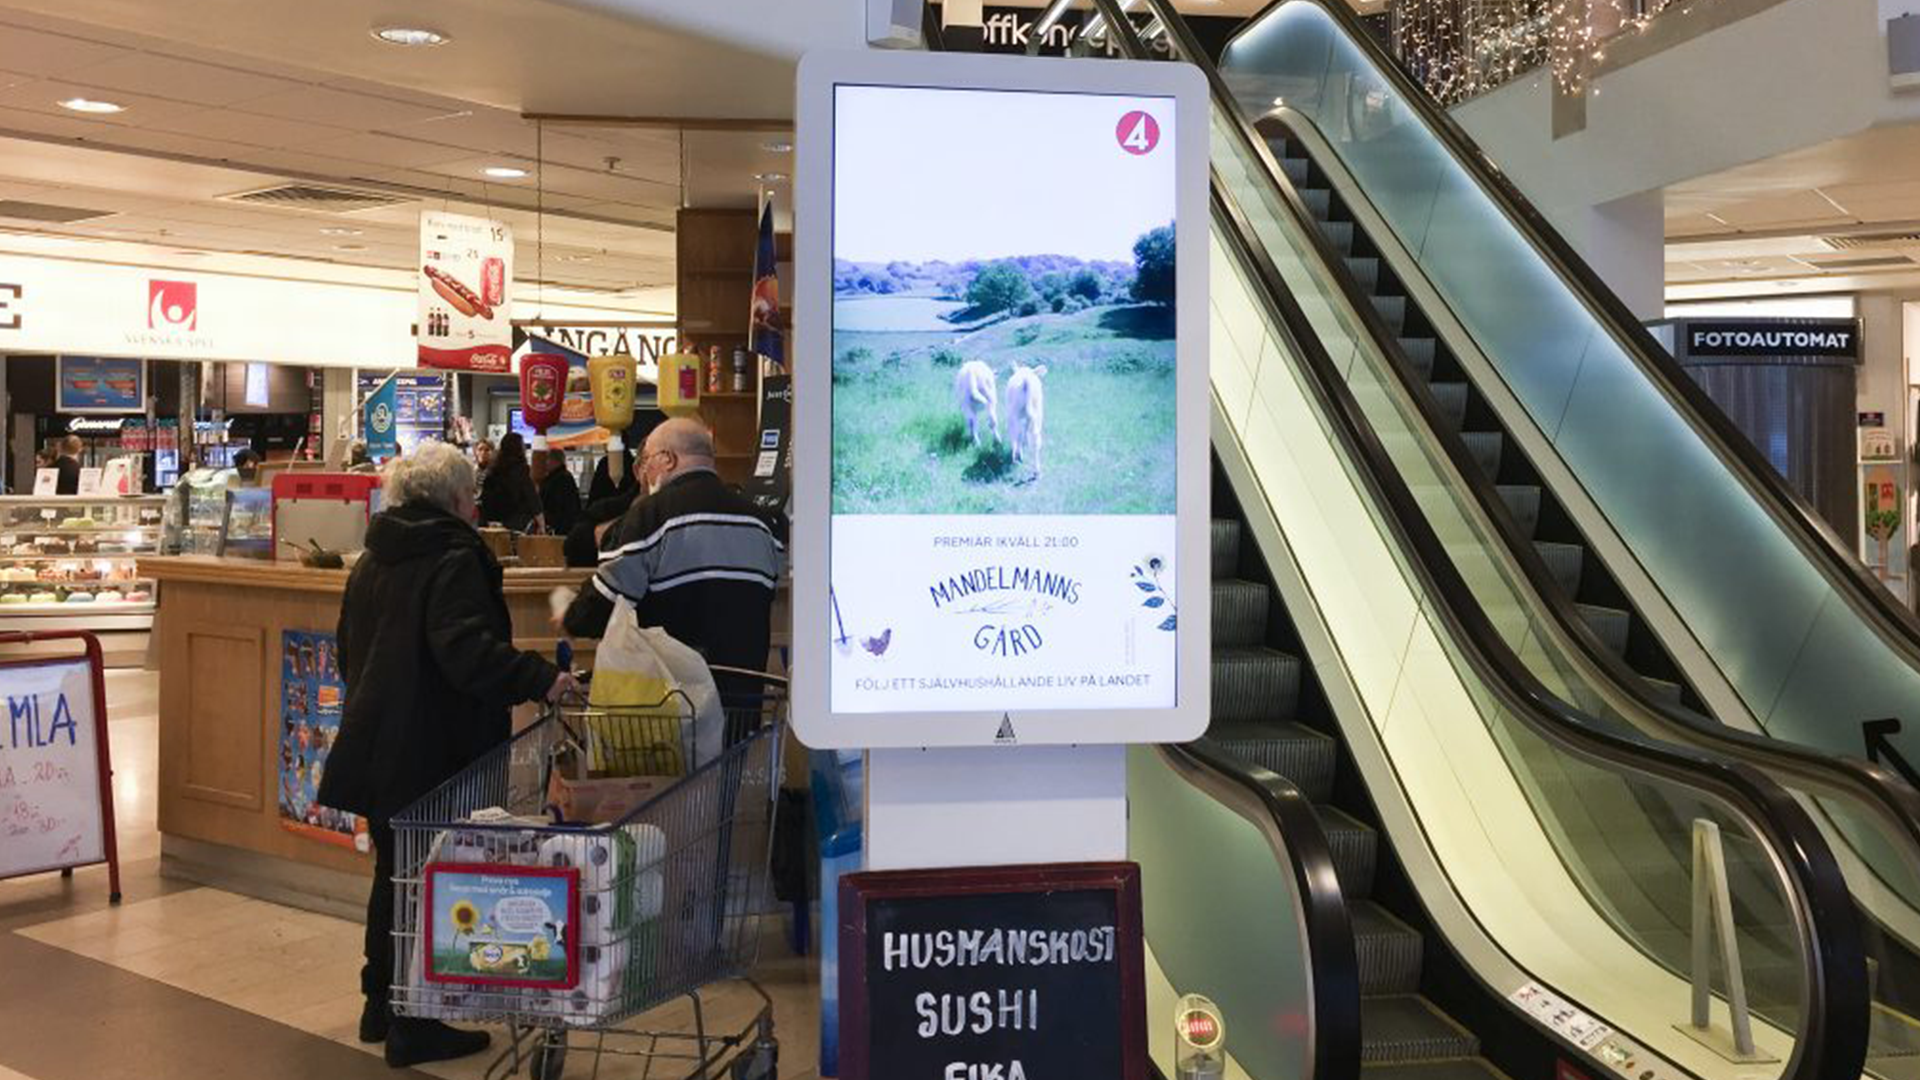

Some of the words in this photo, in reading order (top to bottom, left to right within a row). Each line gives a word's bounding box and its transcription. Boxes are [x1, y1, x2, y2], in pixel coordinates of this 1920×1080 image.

[1694, 332, 1849, 348] FOTOAUTOMAT
[930, 566, 1082, 607] MANDELMANNS
[892, 677, 916, 690] ETT
[1100, 674, 1151, 687] LANDET
[0, 692, 77, 750] MLA
[884, 926, 1115, 971] HUSMANSKOST
[915, 989, 1038, 1038] SUSHI
